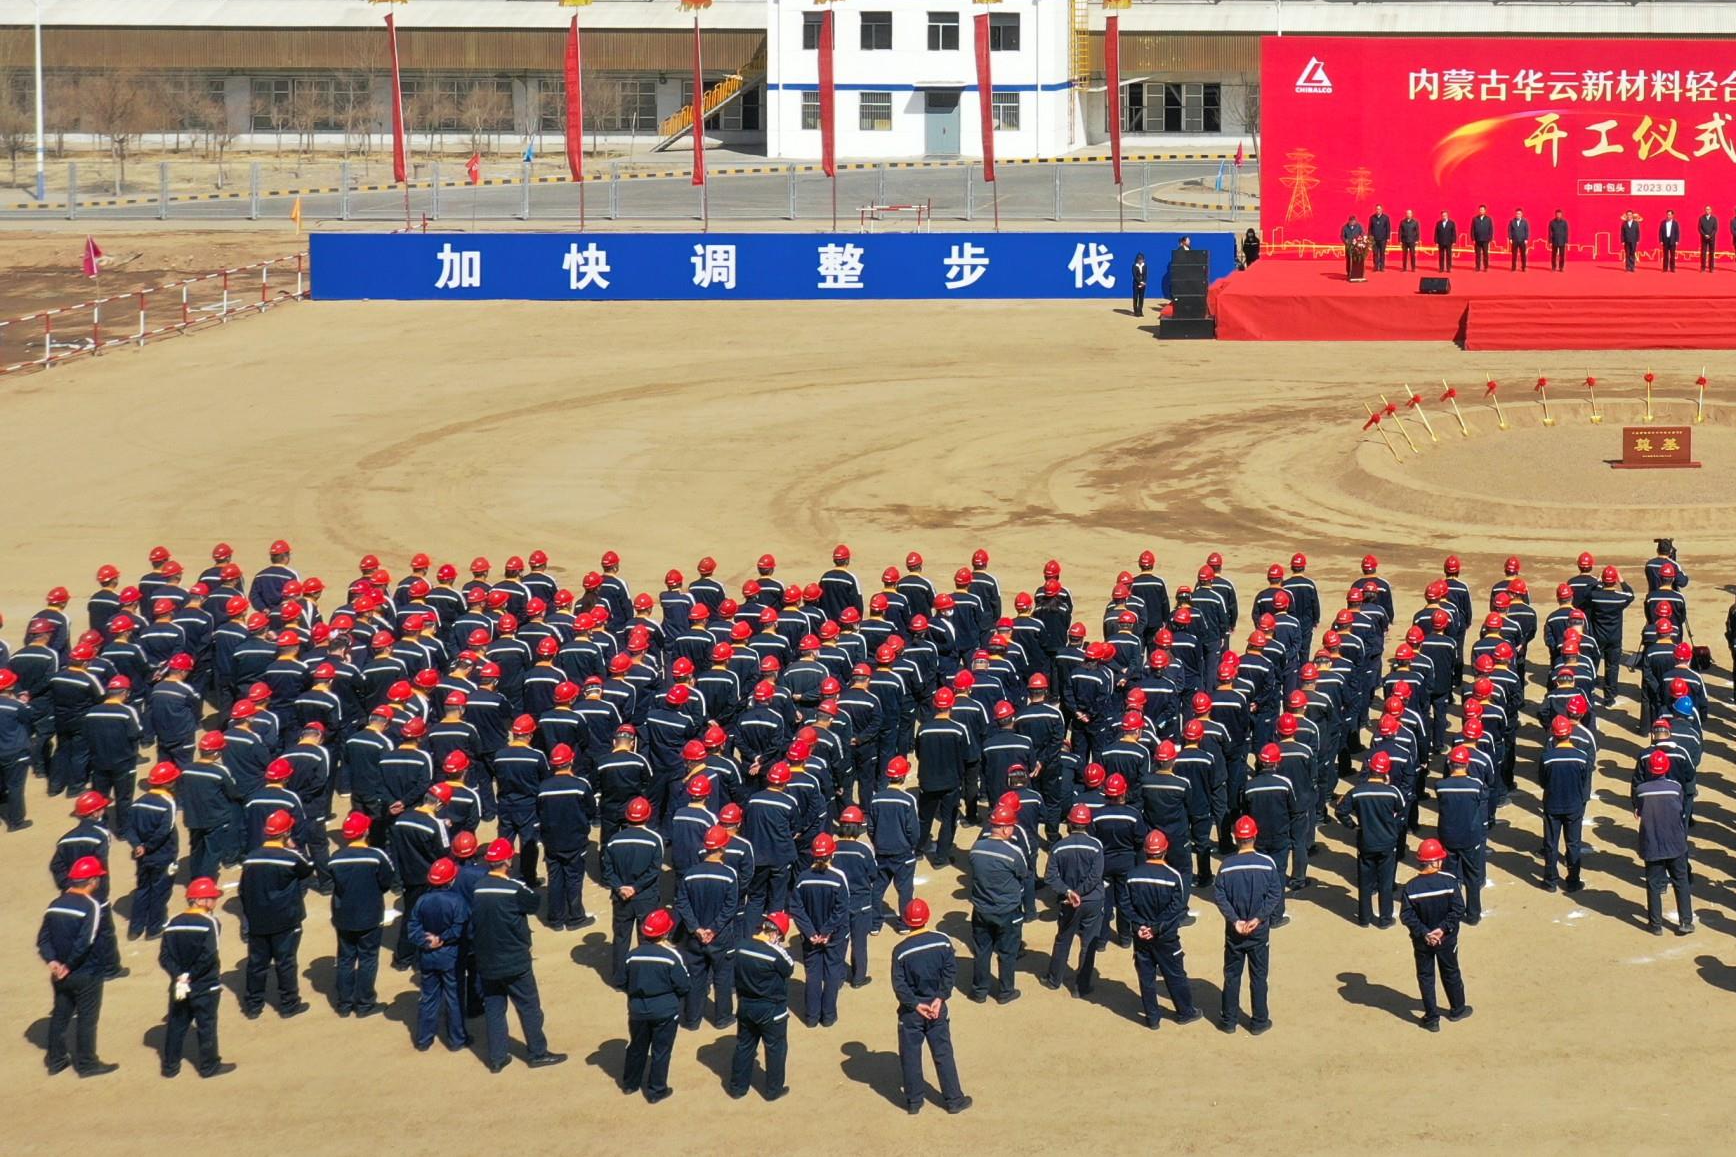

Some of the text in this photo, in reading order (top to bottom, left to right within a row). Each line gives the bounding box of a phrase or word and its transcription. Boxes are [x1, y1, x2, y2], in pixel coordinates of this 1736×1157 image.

[1636, 183, 1678, 192] 202303
[434, 243, 1116, 290] 加快调整步伐
